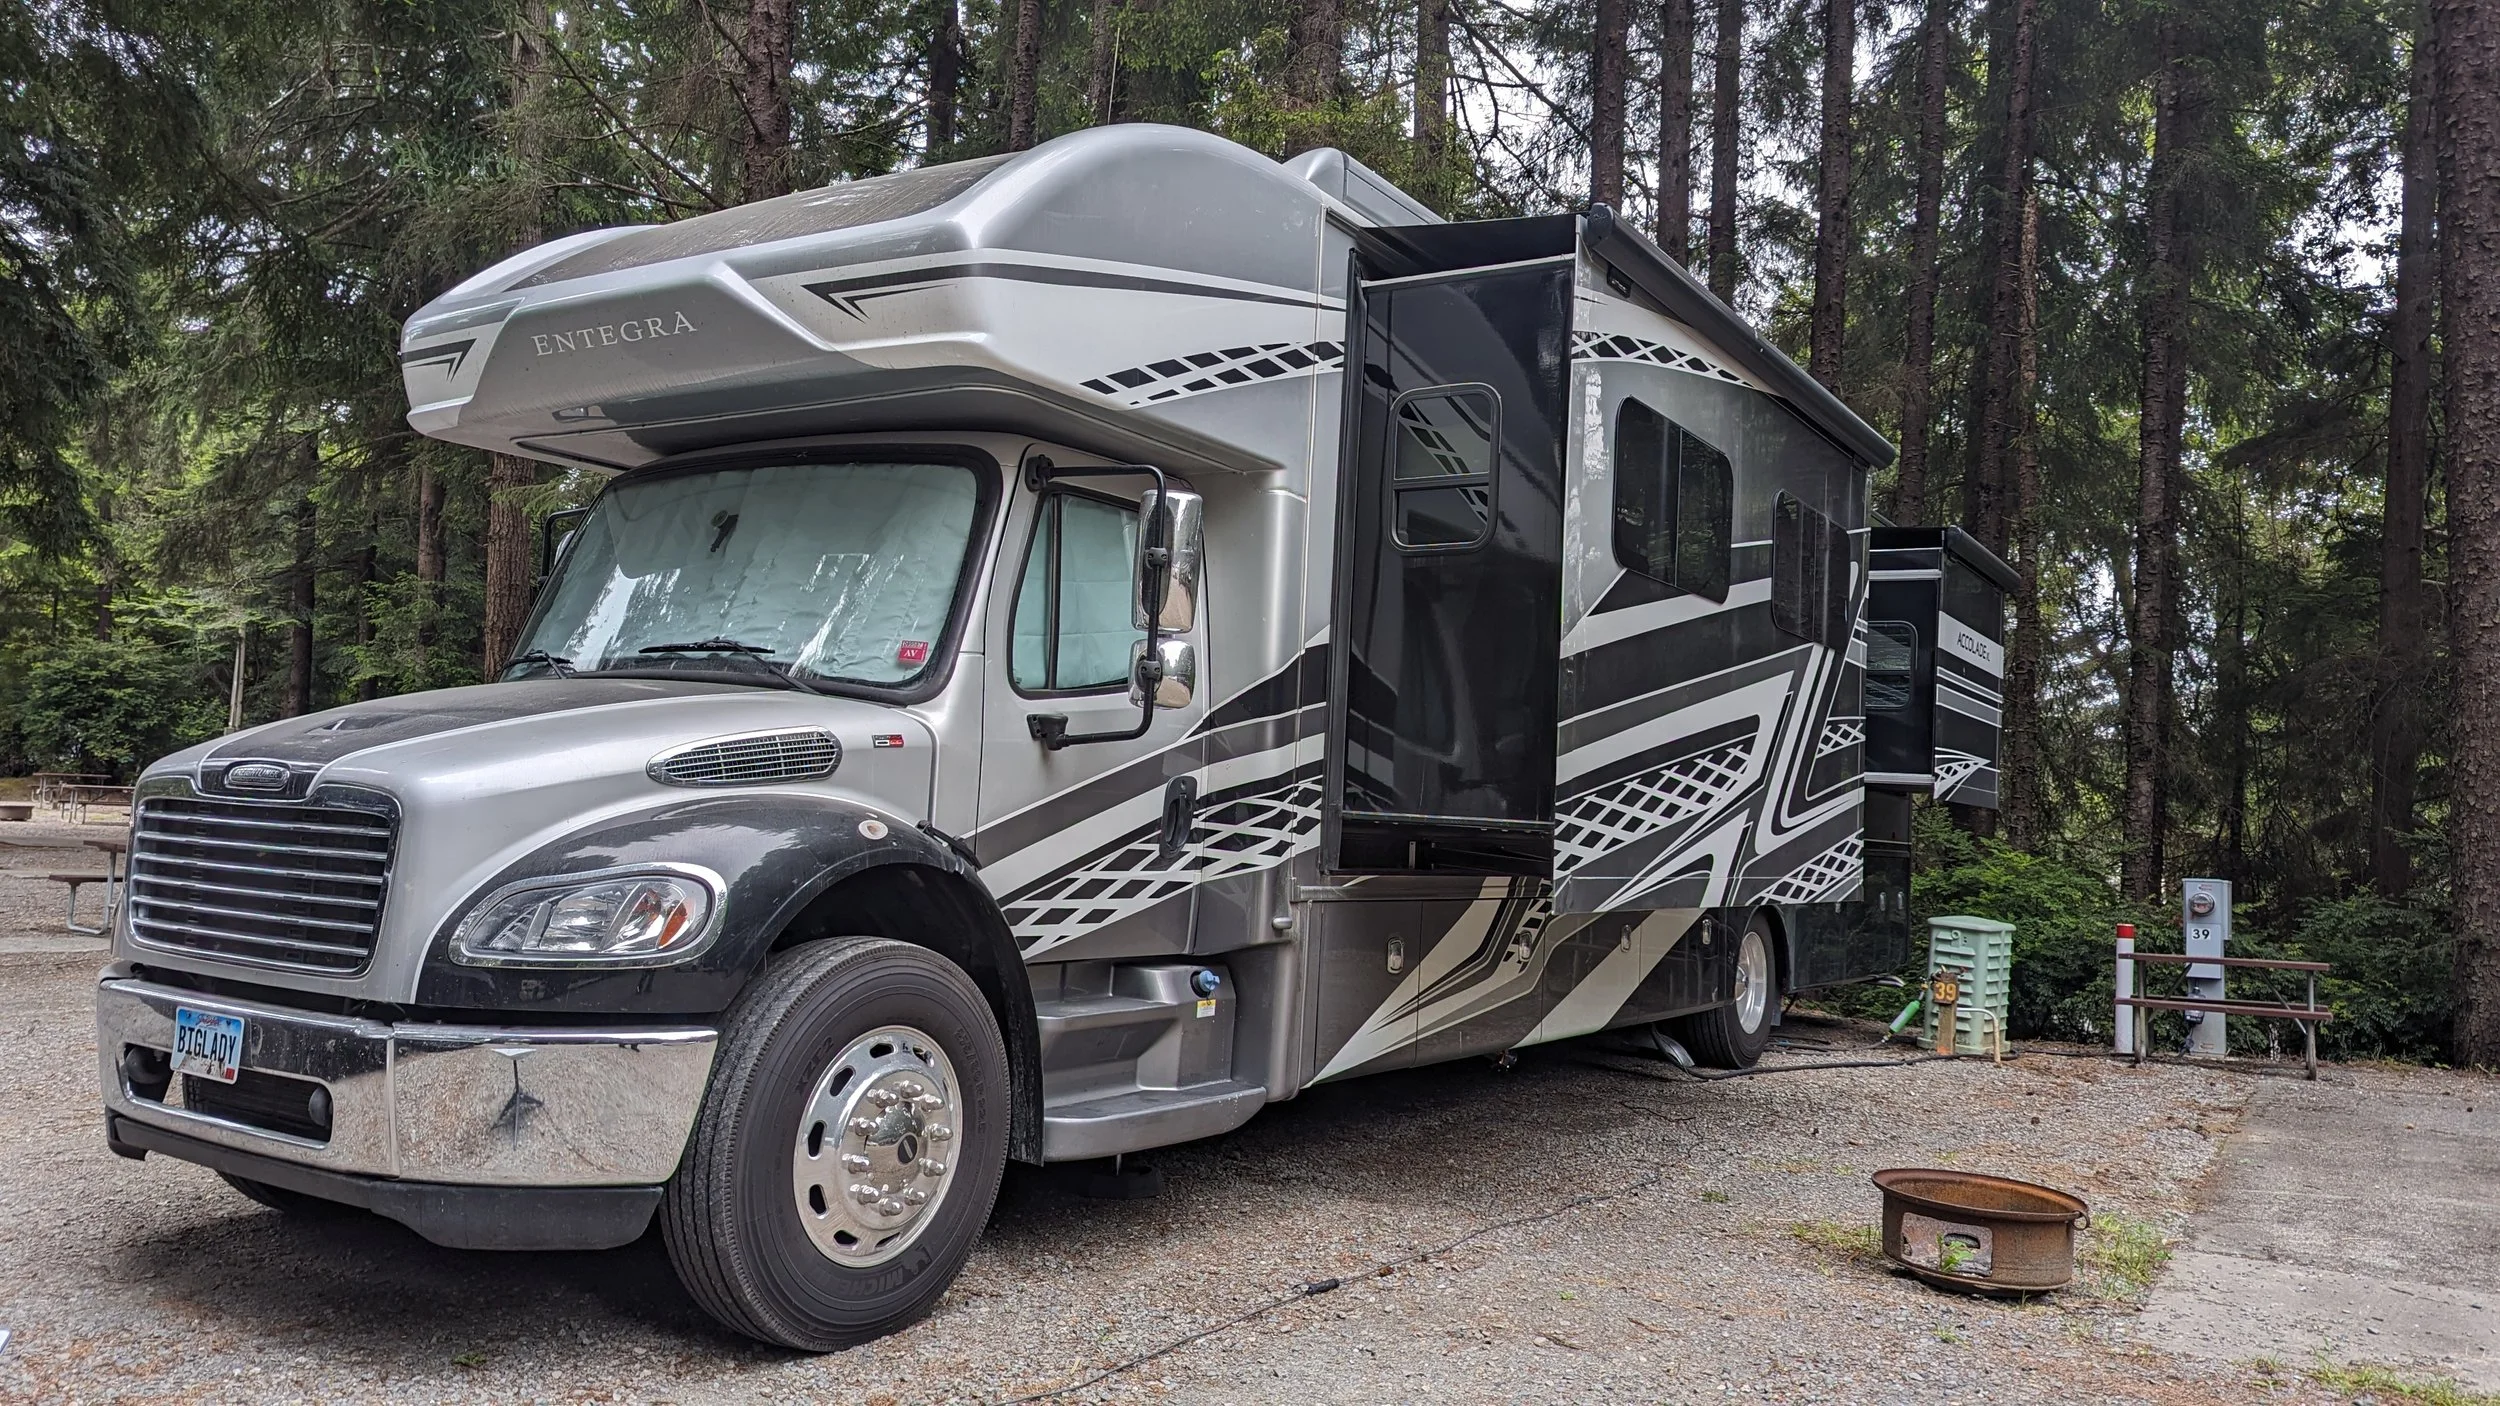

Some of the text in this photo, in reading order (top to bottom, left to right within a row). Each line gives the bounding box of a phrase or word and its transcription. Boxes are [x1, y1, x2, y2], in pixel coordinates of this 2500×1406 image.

[530, 311, 698, 356] ENTEGRA
[1957, 632, 1987, 659] ACCOLADE
[2192, 929, 2210, 940] 39
[1935, 982, 1957, 1002] 39
[177, 1025, 237, 1065] BIGLADY
